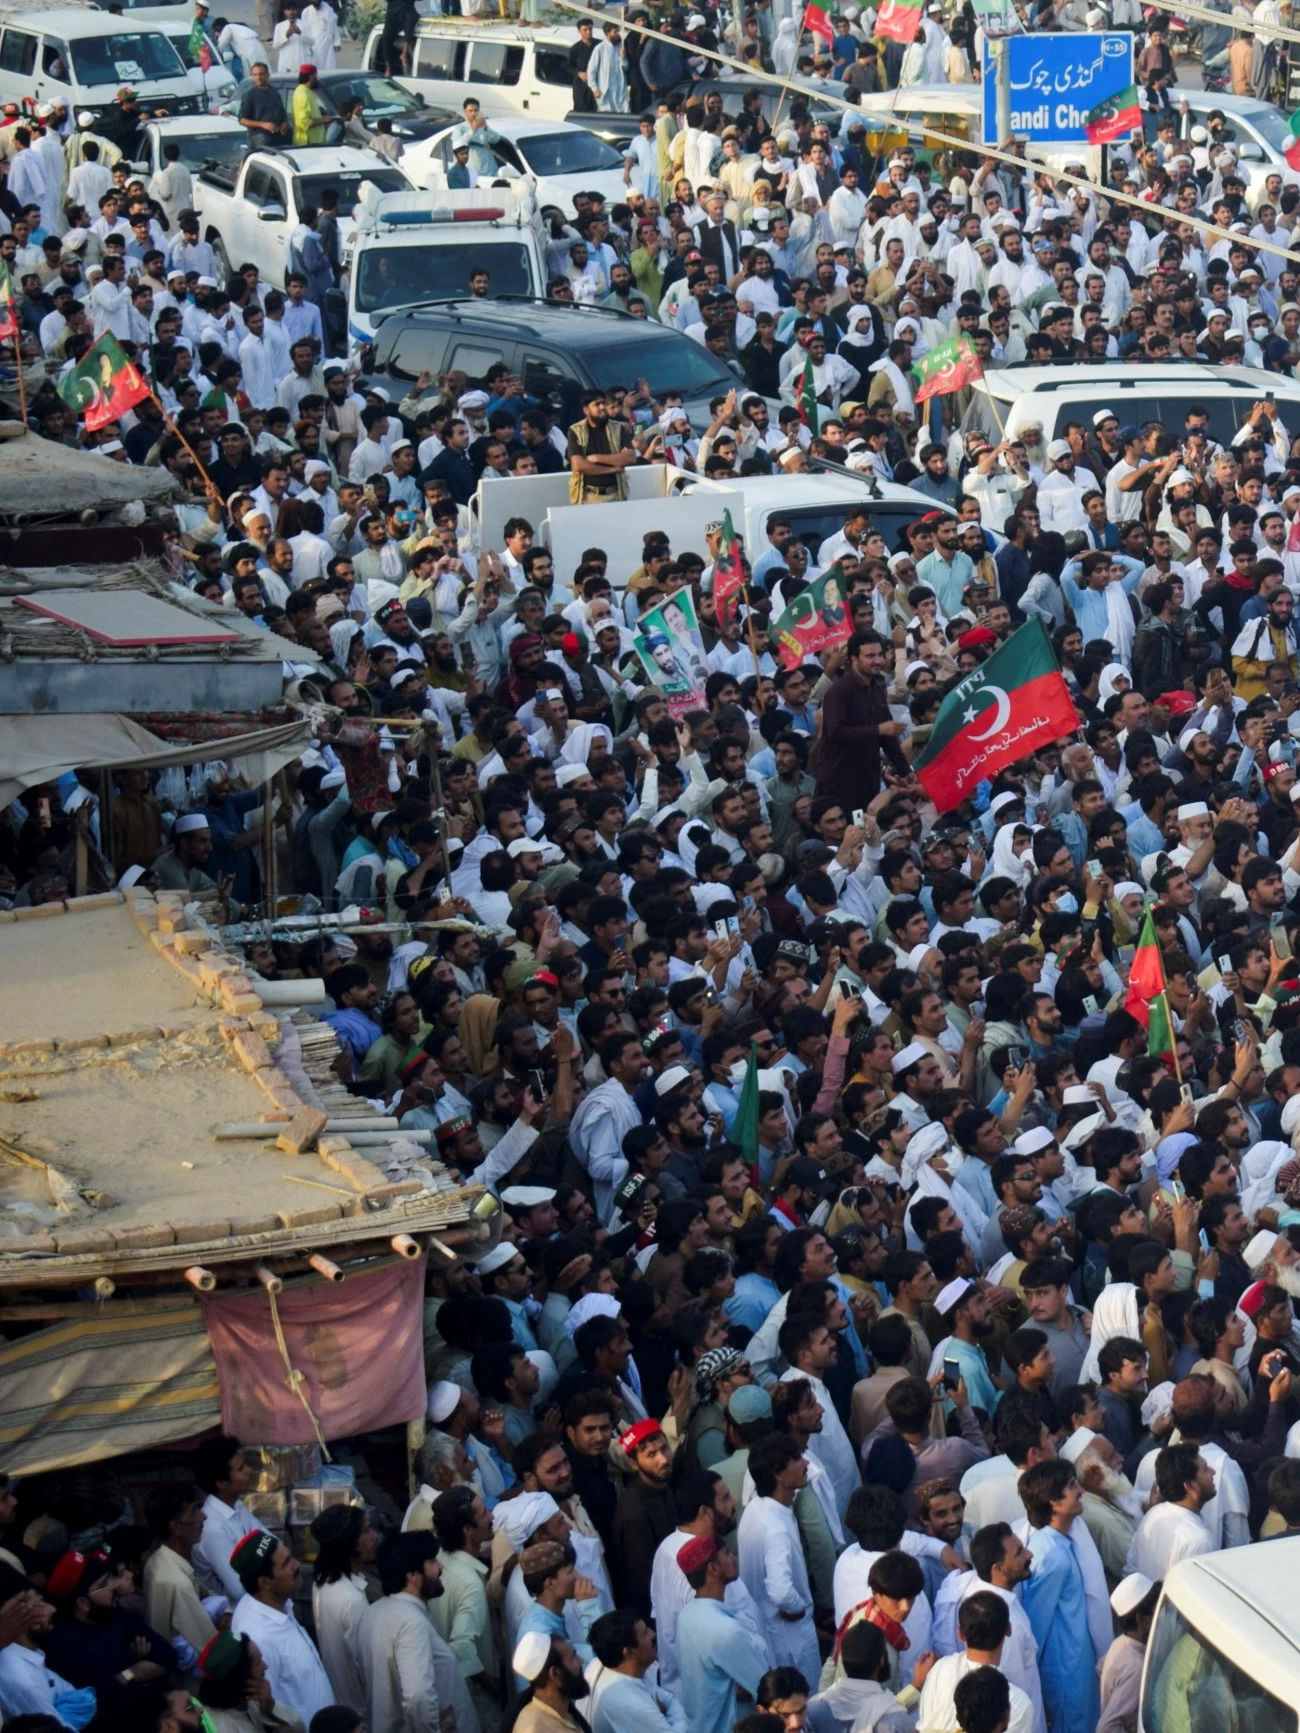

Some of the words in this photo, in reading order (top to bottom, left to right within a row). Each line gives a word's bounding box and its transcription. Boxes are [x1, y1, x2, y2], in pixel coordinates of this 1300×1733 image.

[1010, 59, 1052, 96] چوک
[996, 105, 1049, 130] andi
[1055, 104, 1091, 130] Cho
[1275, 762, 1290, 773] 804
[621, 1181, 637, 1198] ISF
